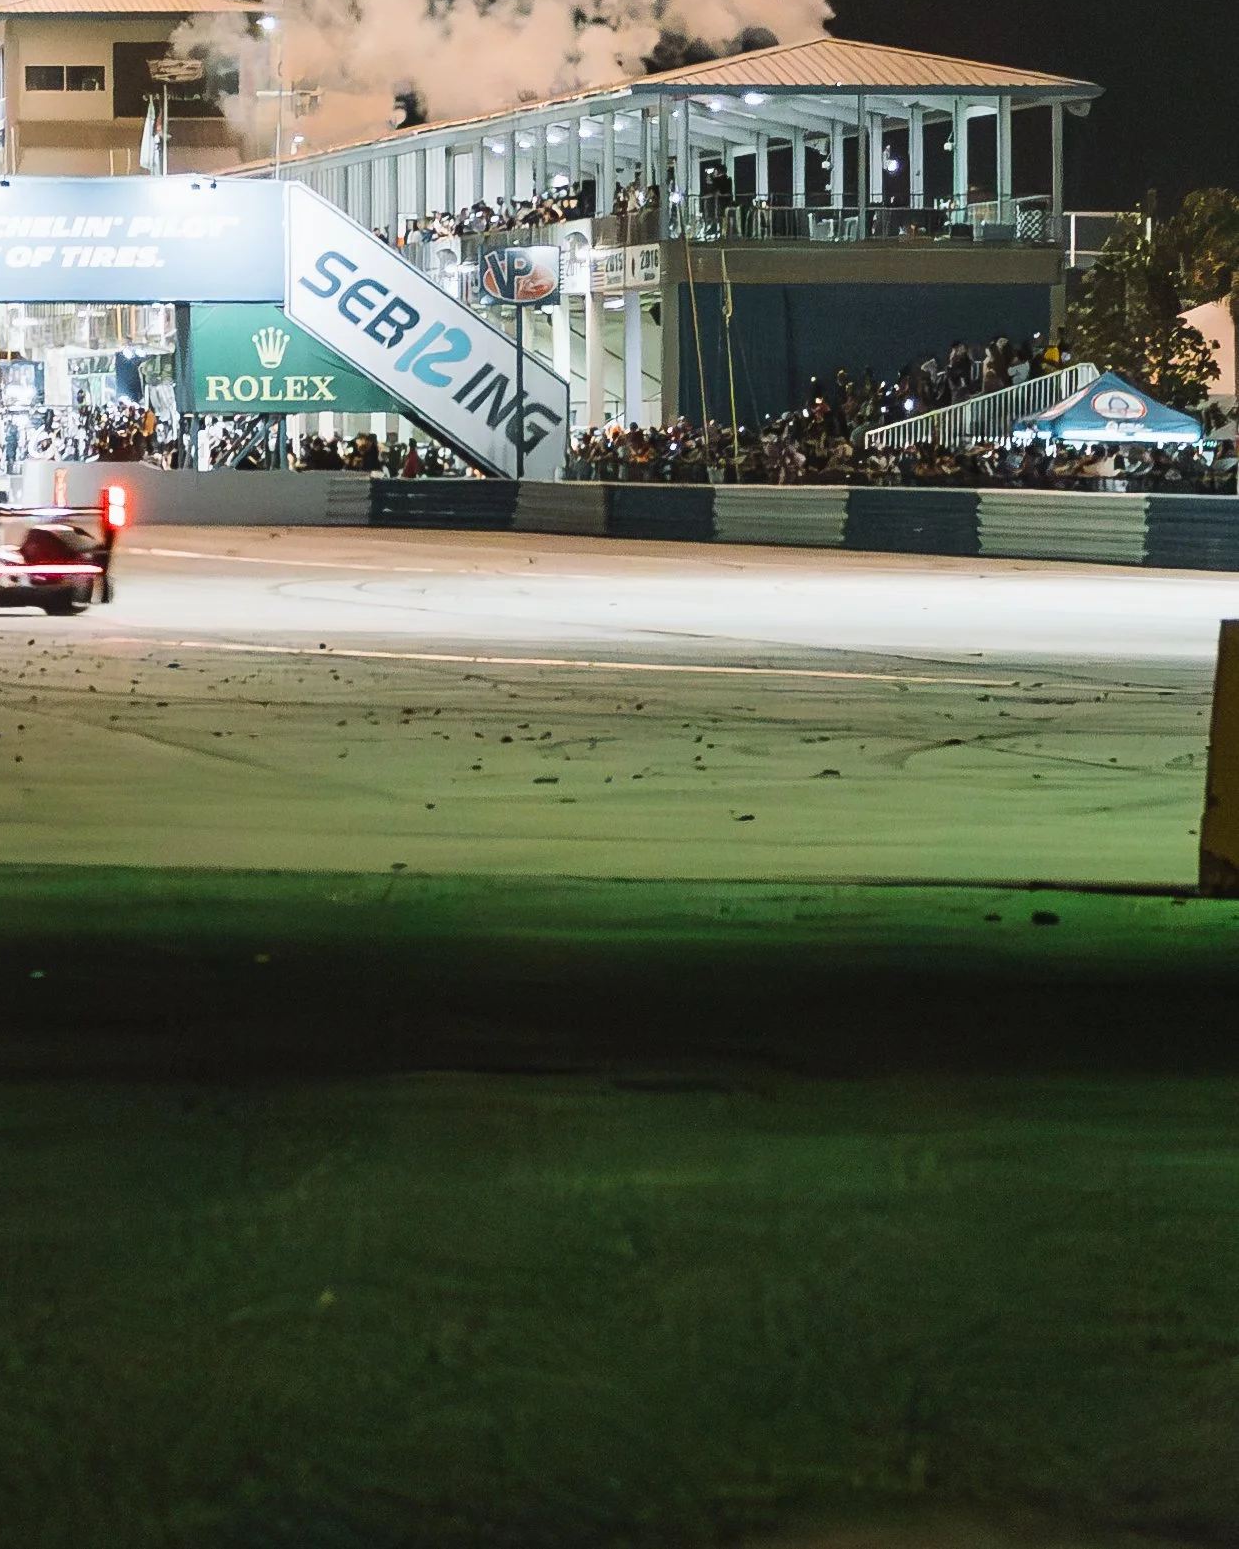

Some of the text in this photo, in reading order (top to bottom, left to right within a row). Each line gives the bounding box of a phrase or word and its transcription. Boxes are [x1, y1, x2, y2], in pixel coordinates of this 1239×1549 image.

[5, 246, 57, 269] OF
[60, 246, 166, 269] TIRES.
[484, 247, 533, 301] VP
[205, 374, 337, 403] ROLEX
